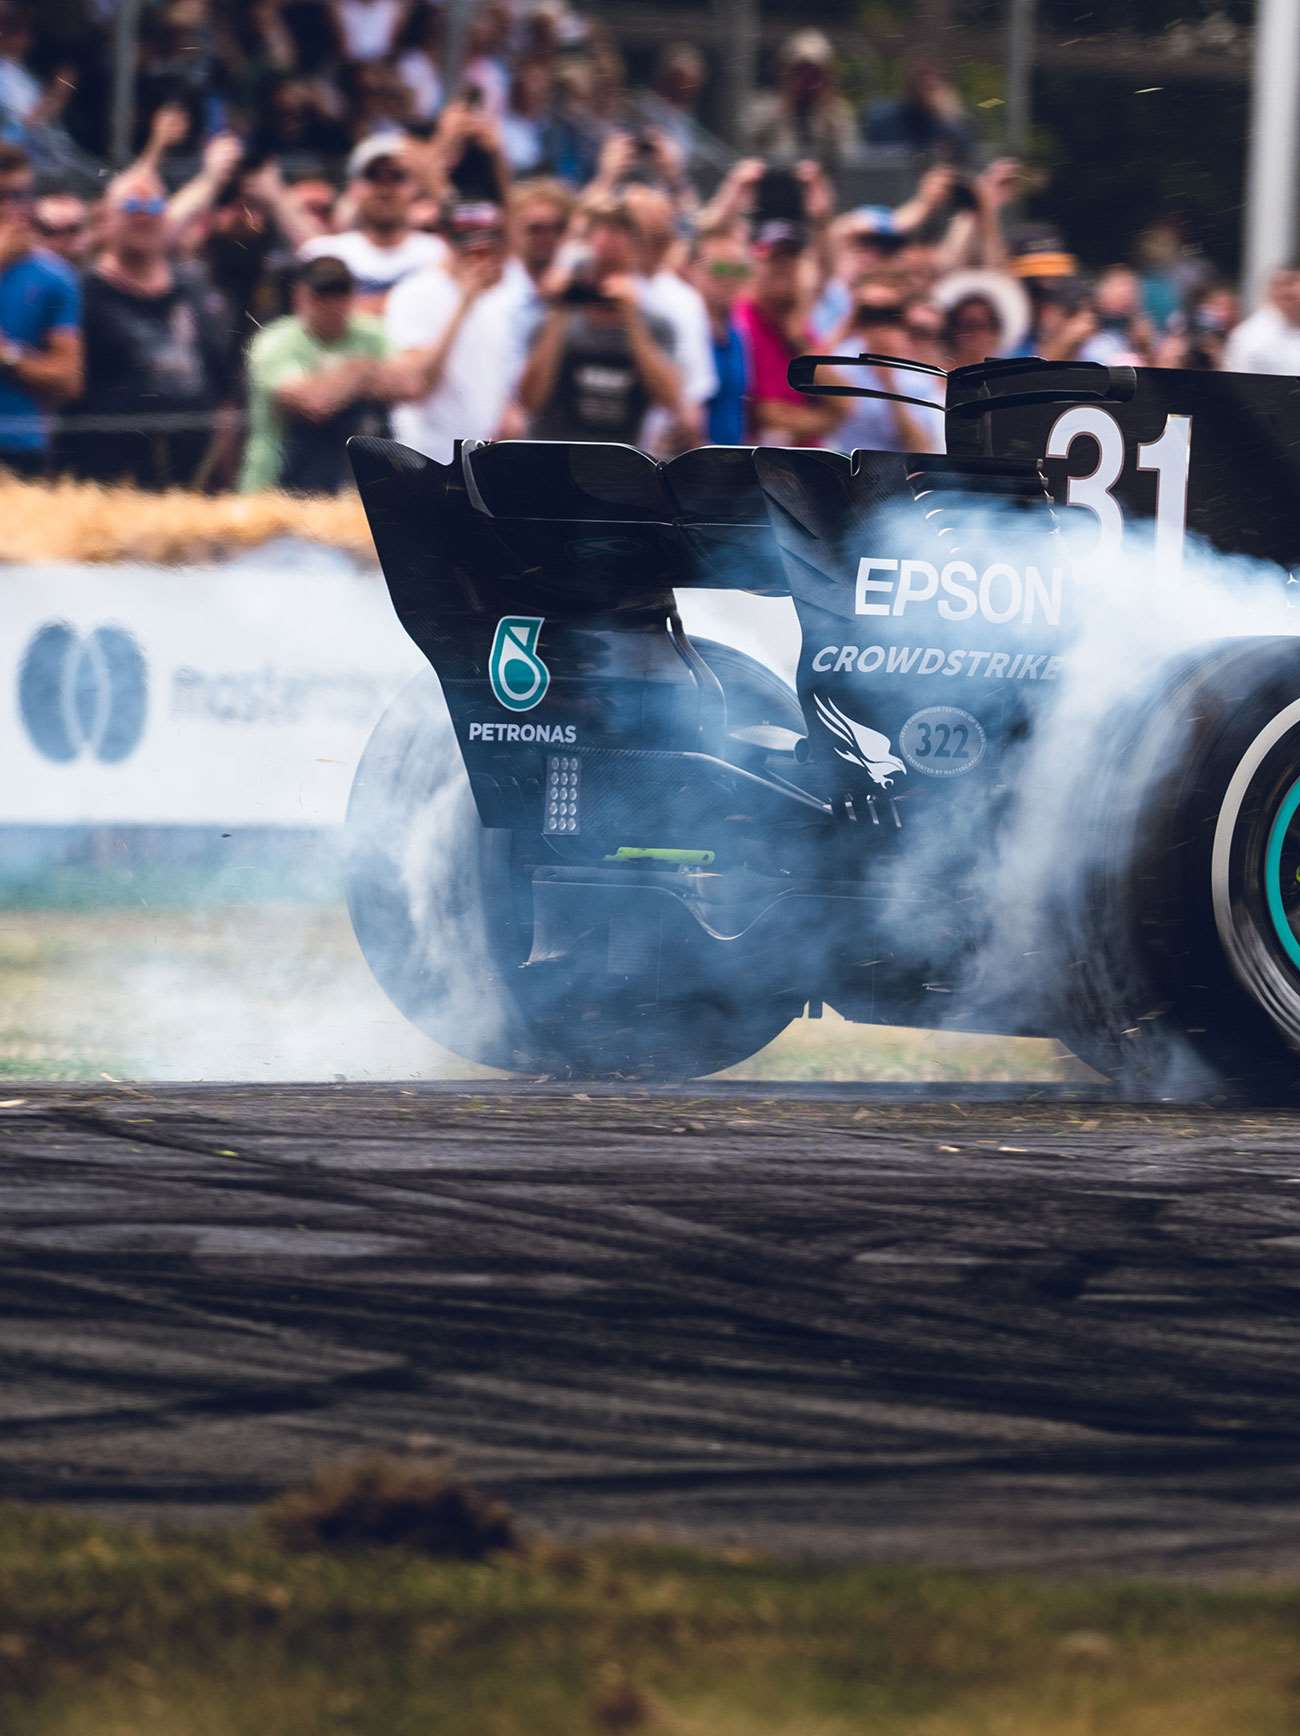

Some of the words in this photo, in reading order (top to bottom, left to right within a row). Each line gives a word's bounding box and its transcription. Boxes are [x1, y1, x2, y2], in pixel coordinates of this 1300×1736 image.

[1046, 405, 1192, 572] 31
[855, 557, 1063, 626] EPSON
[811, 645, 1066, 681] CROWDSTRIKE
[469, 722, 577, 743] PETRONAS
[915, 722, 969, 758] 322
